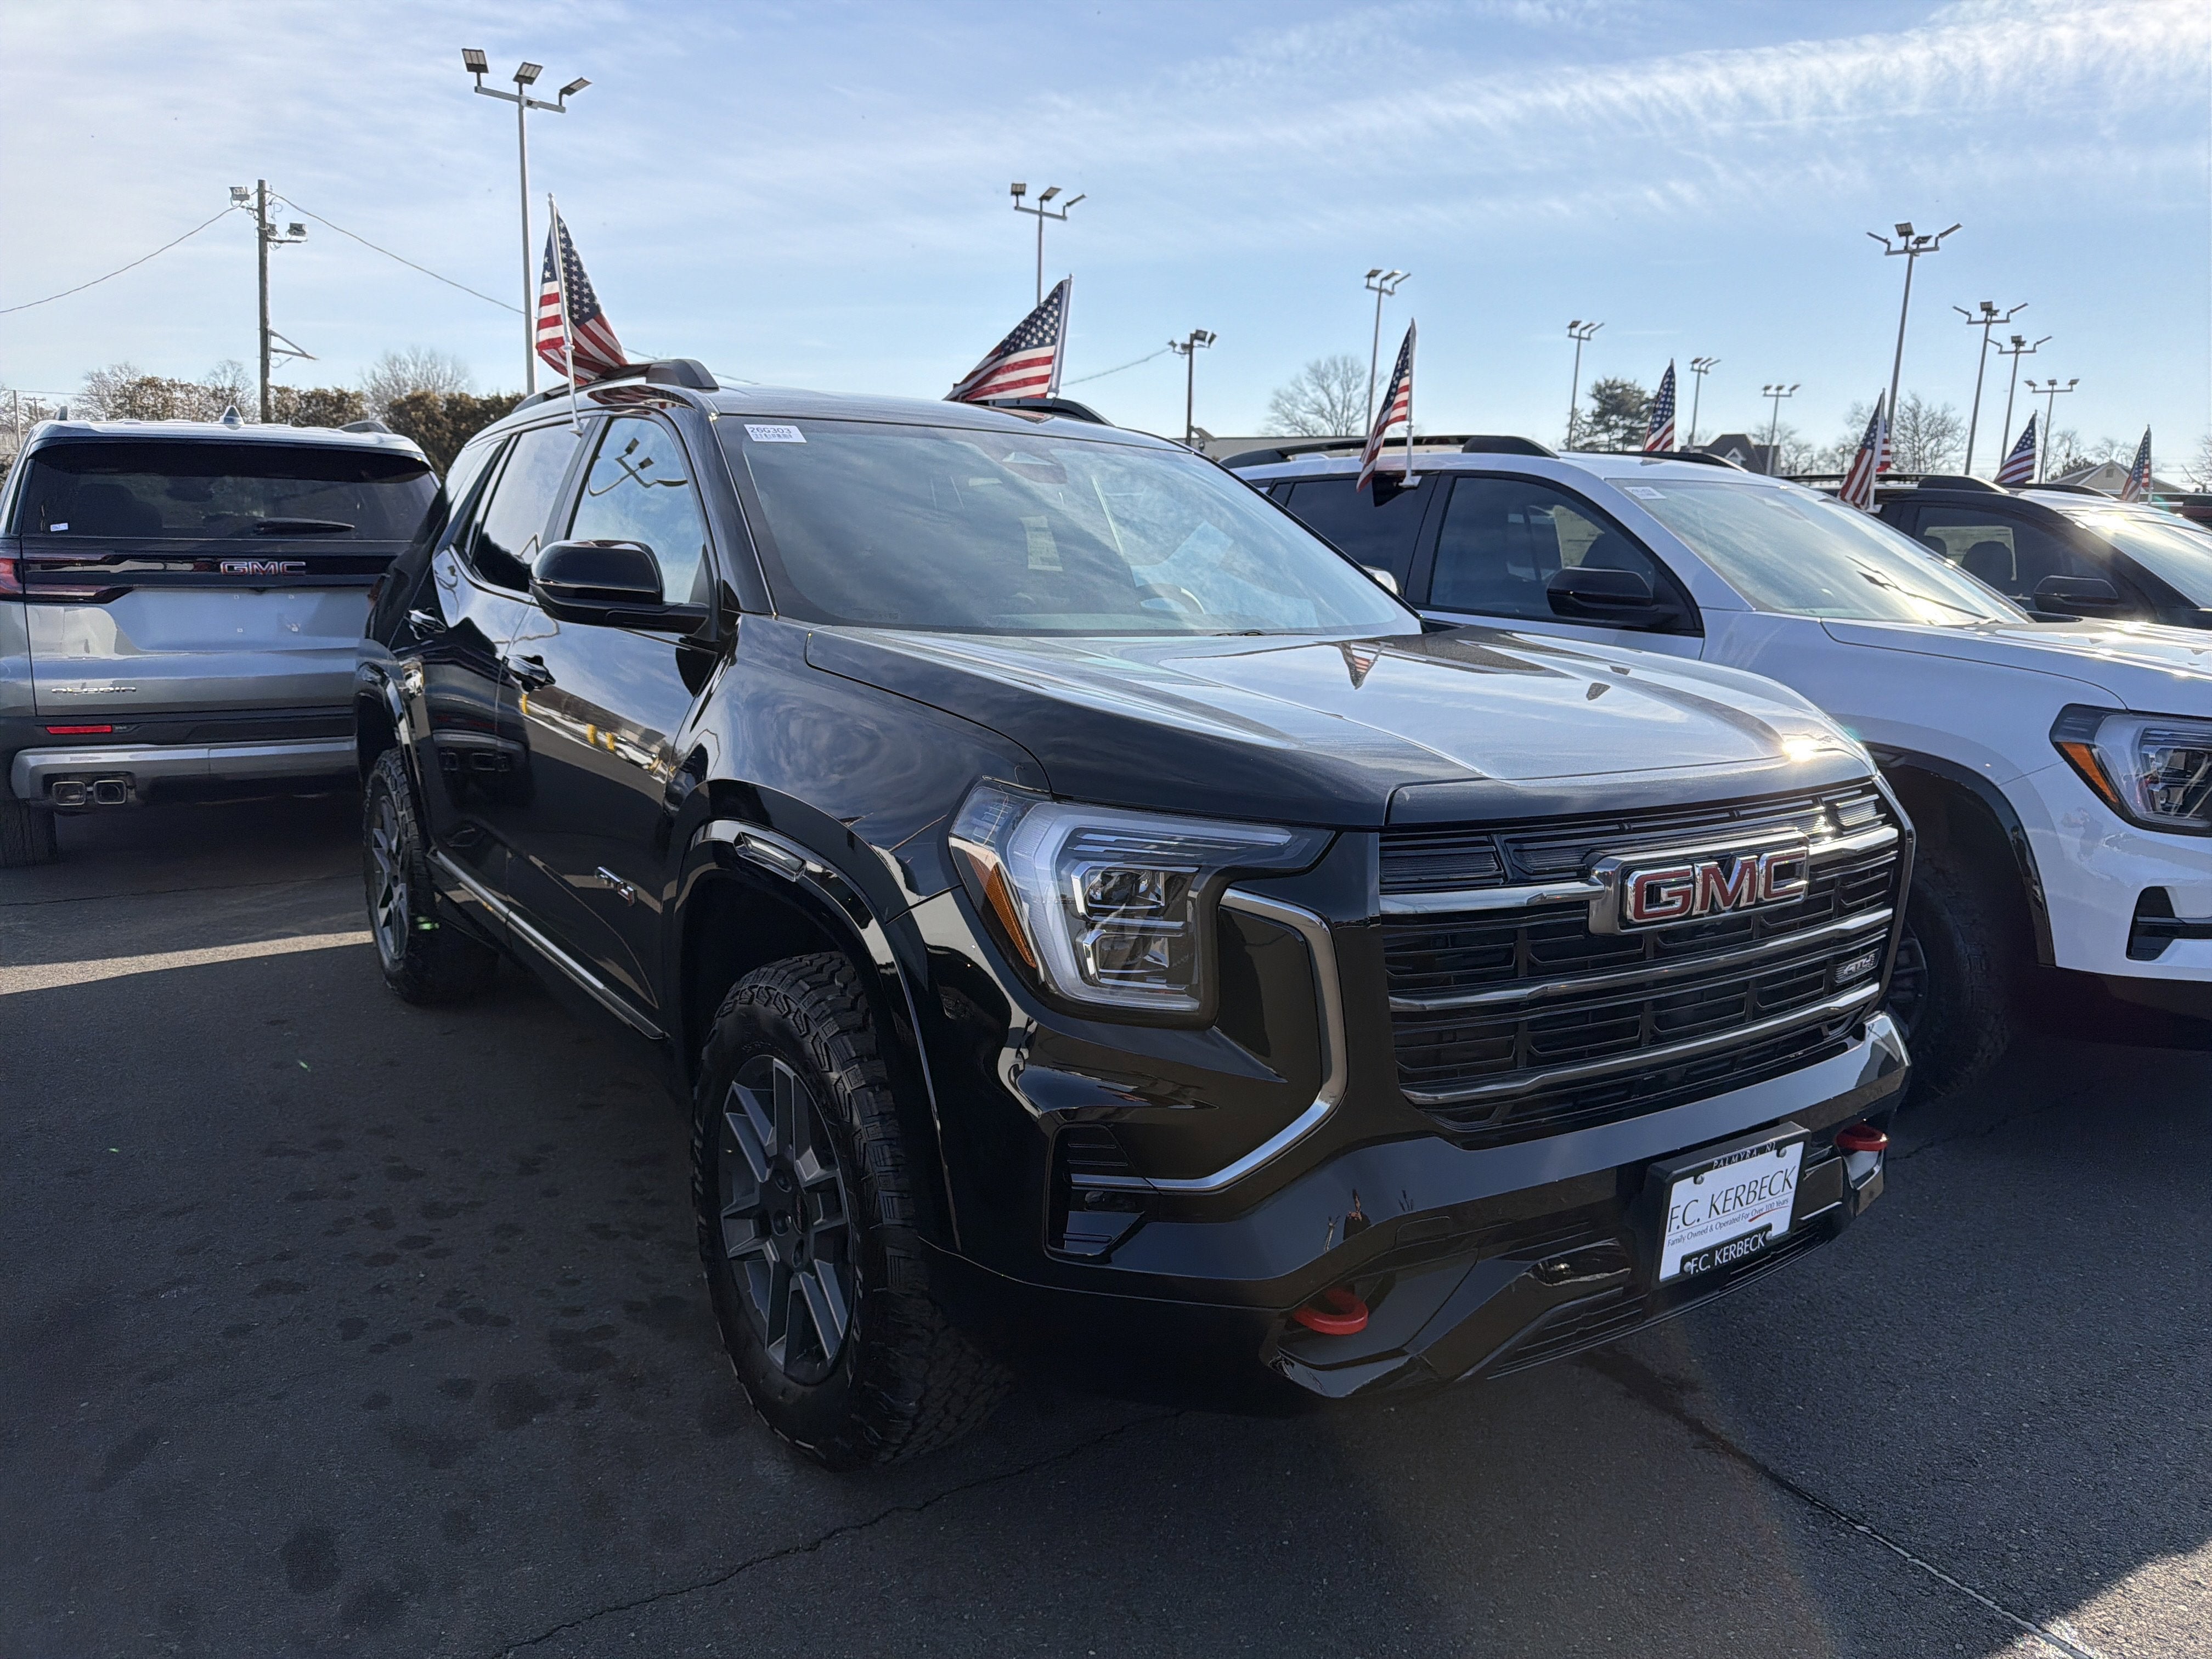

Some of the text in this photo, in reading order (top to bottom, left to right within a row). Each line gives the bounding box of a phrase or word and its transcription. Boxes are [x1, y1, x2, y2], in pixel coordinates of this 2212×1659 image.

[220, 561, 306, 575] GMC
[1627, 846, 1809, 923] GMC
[1667, 1198, 1789, 1247] Family Owned & Operated For Over 100 Years
[1668, 1166, 1796, 1233] F.C. KERBECK
[1690, 1231, 1765, 1275] F.C. KERBECK
